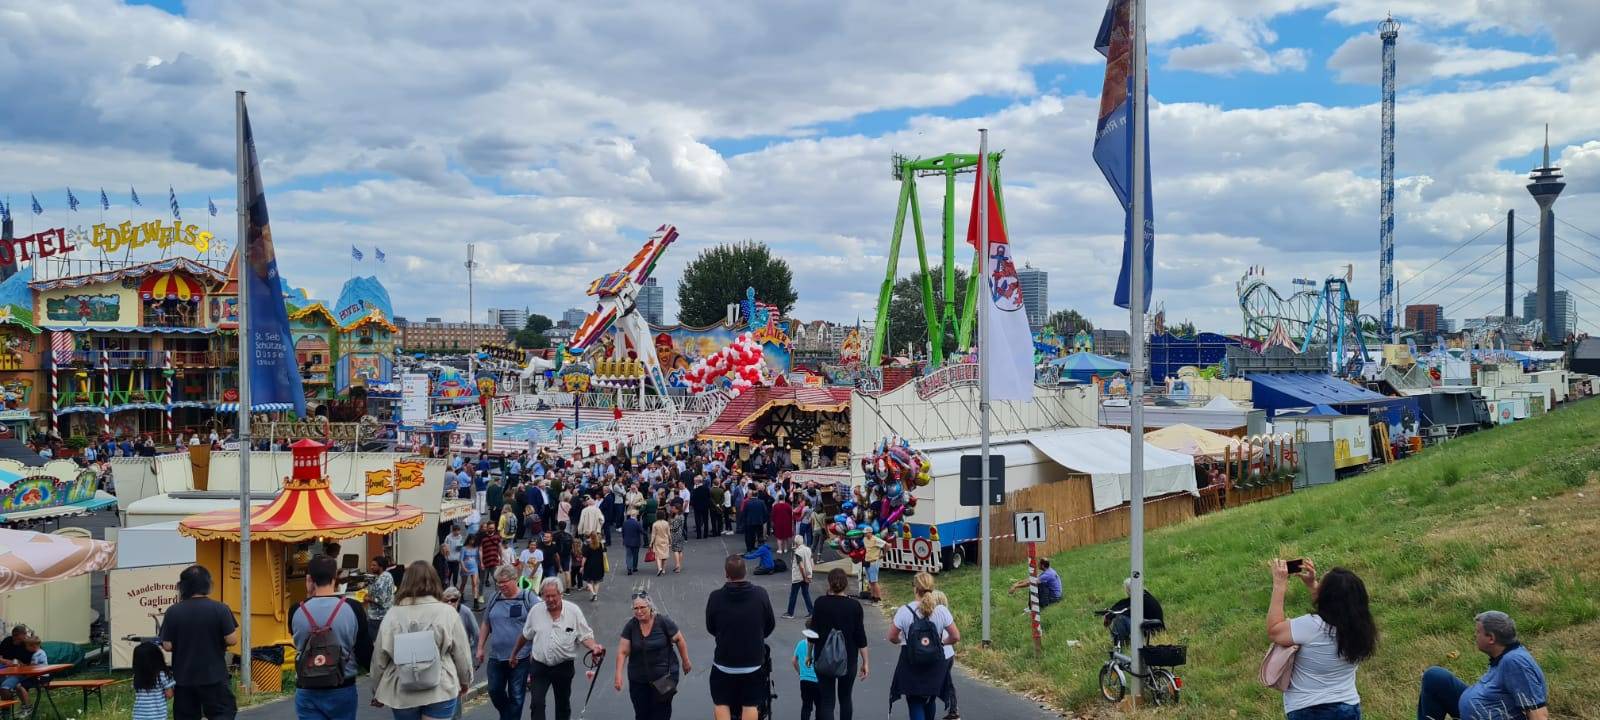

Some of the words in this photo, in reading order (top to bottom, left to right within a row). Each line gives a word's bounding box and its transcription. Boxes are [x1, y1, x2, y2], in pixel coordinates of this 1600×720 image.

[0, 226, 75, 266] OTEL
[91, 219, 214, 254] EDELWEISS
[1021, 515, 1041, 539] 11
[139, 594, 179, 608] Gagliard
